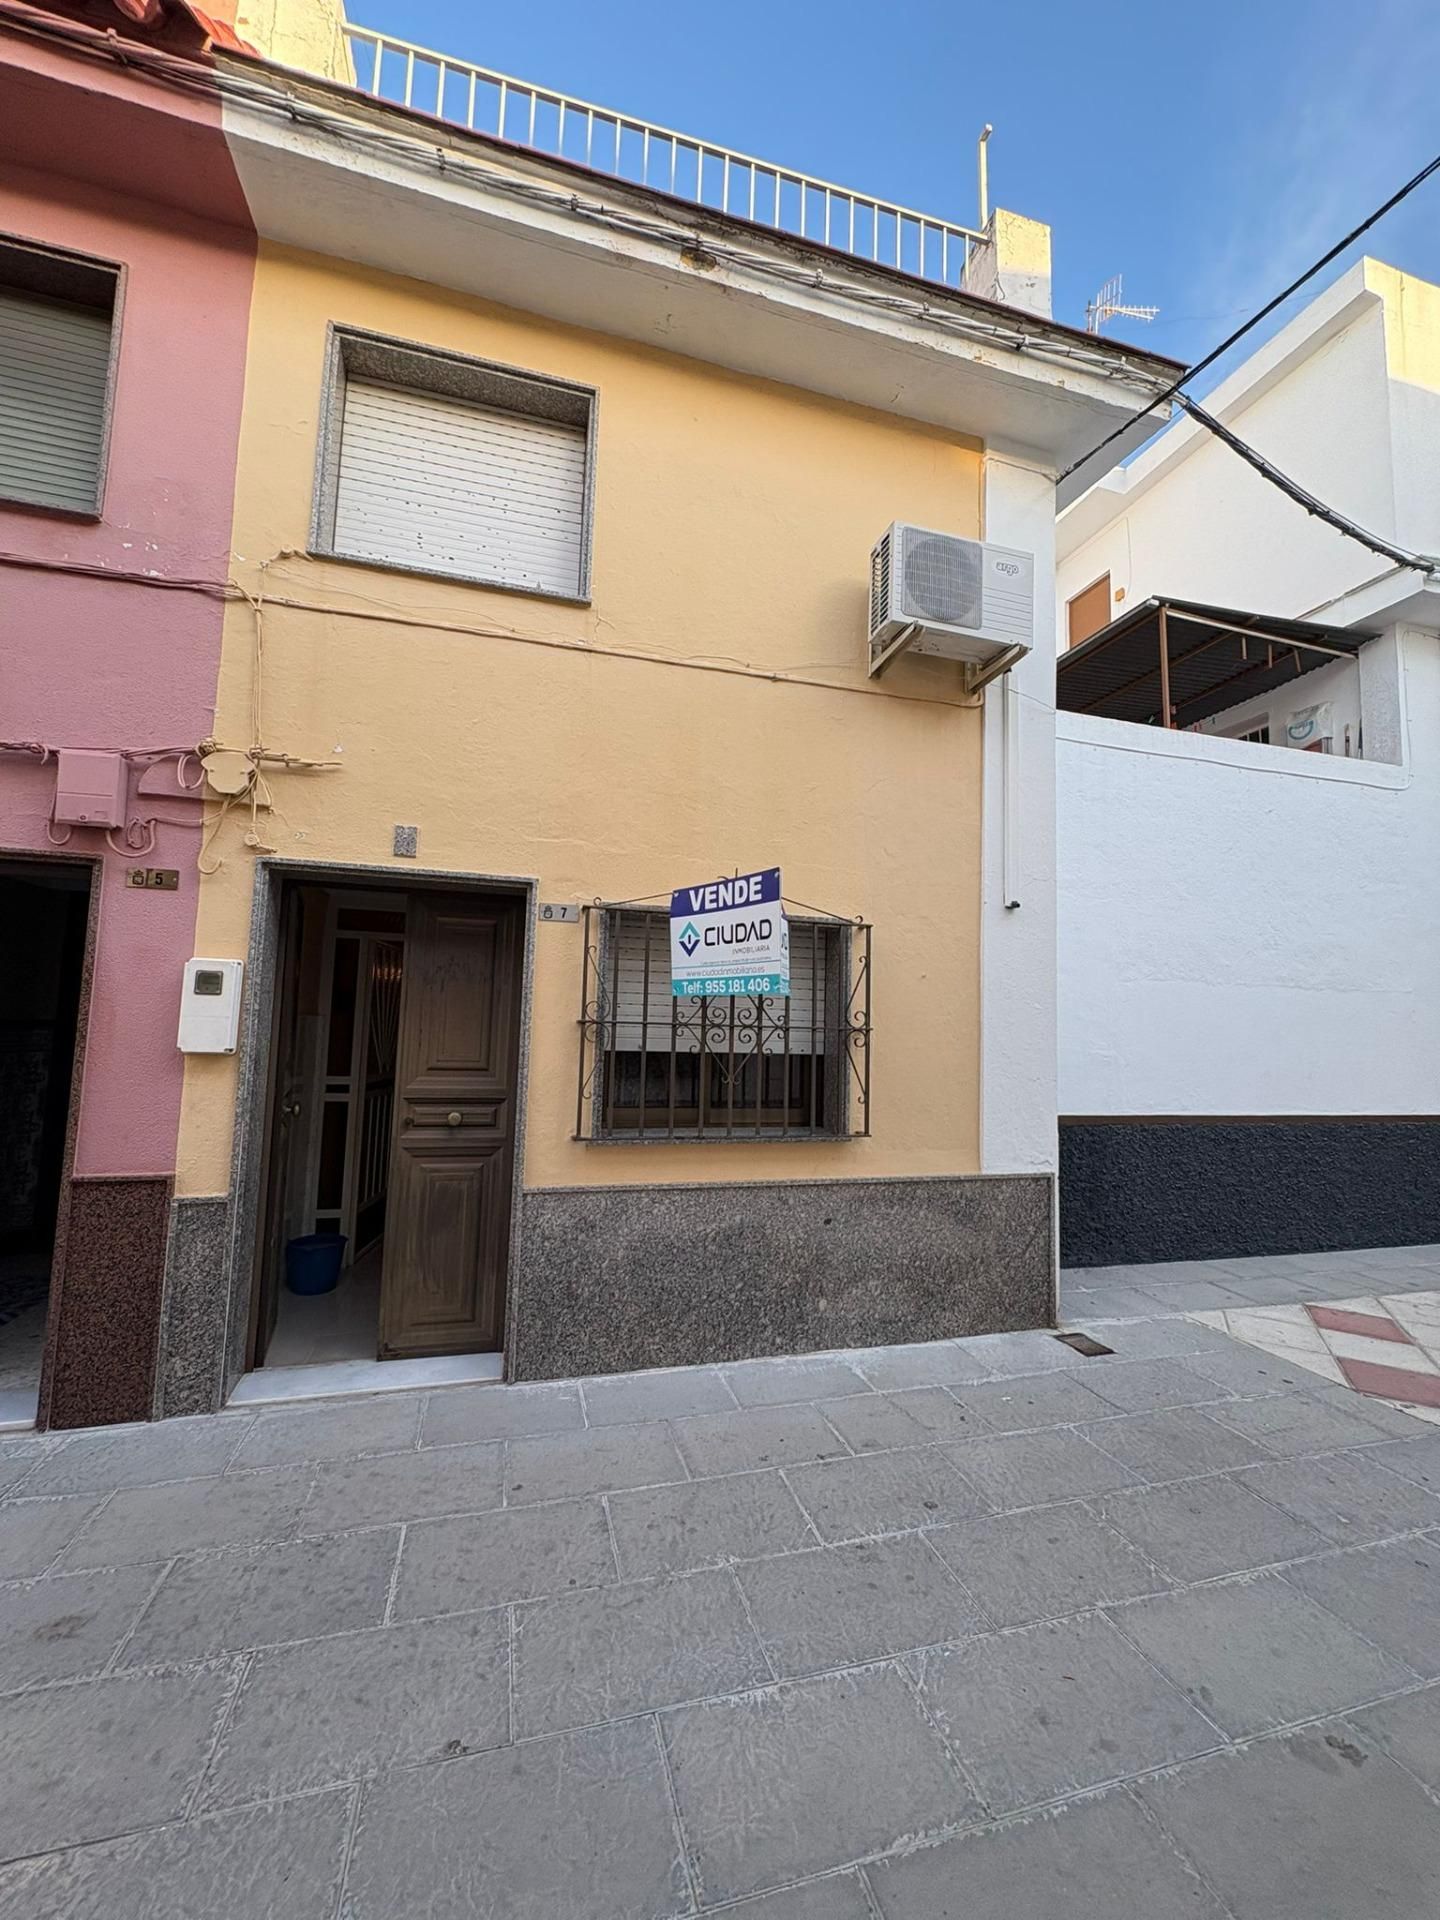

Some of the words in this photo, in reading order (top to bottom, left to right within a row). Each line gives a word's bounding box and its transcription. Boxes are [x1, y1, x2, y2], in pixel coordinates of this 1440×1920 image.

[996, 562, 1019, 576] argo
[155, 872, 163, 885] 5
[689, 875, 762, 912] VENDE
[561, 906, 567, 918] 7
[704, 918, 772, 947] CIUDAD
[732, 945, 770, 955] INMOBILIARIA
[682, 981, 703, 994] Telf:
[705, 980, 726, 993] 955
[728, 979, 745, 992] 181
[748, 978, 771, 992] 406
